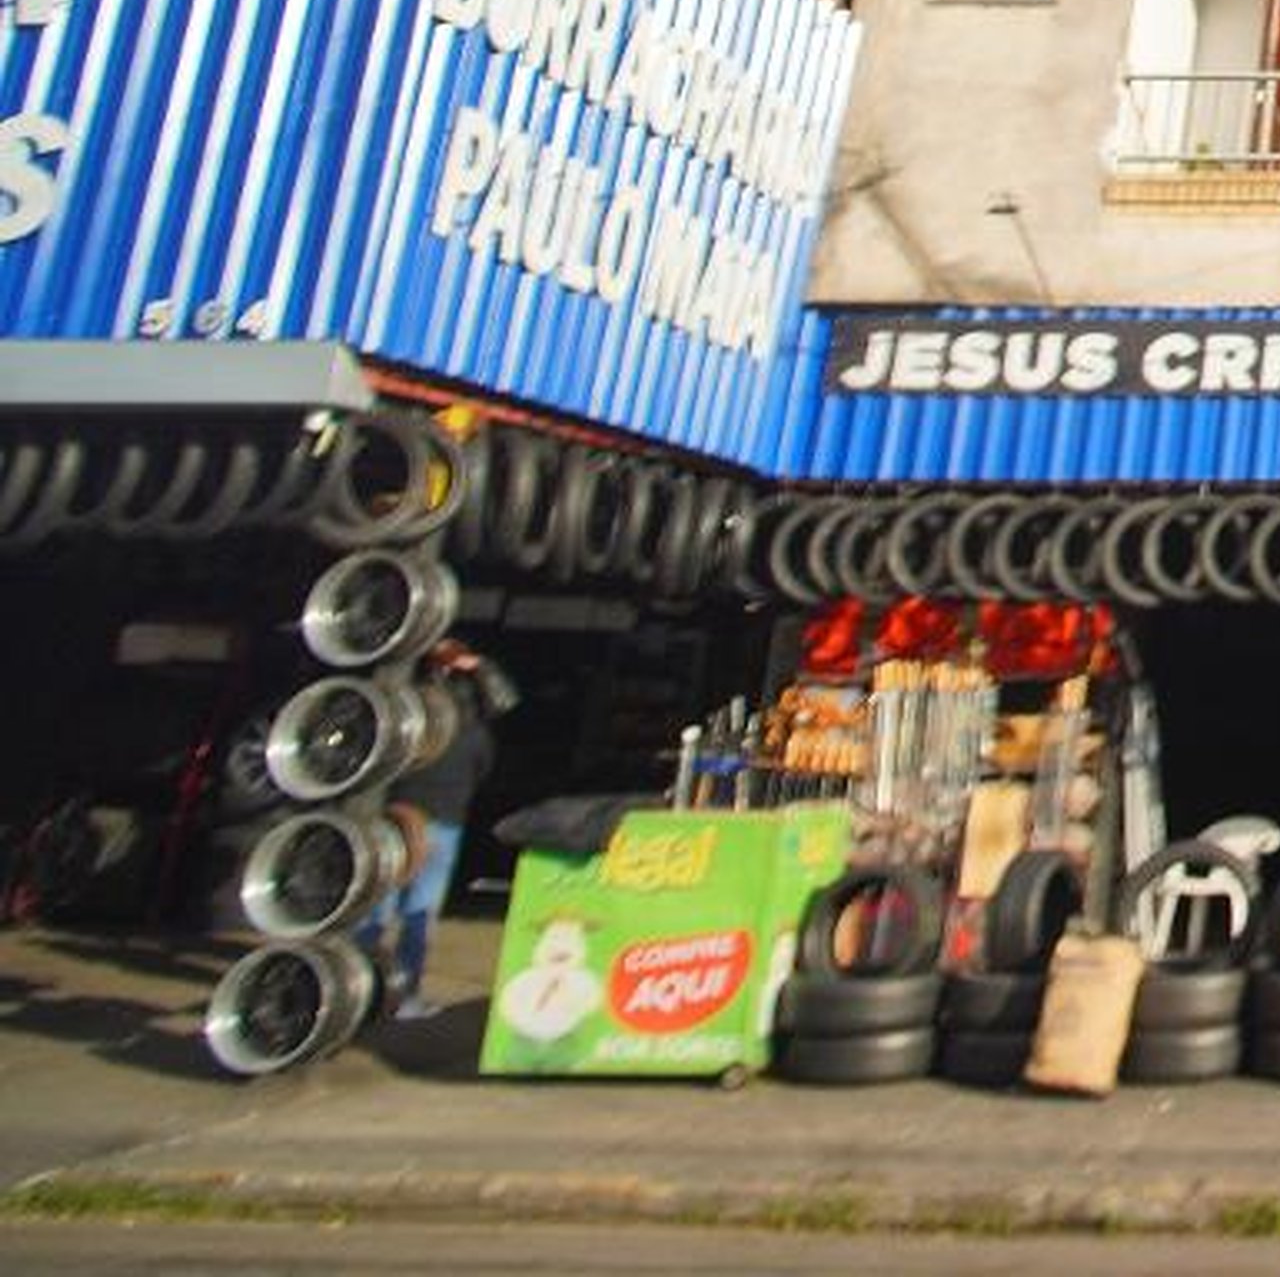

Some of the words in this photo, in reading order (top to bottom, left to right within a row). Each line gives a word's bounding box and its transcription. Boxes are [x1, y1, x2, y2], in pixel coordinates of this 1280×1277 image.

[432, 106, 644, 303] PAULO
[841, 331, 1120, 391] JESUS
[621, 962, 729, 1013] AQUI
